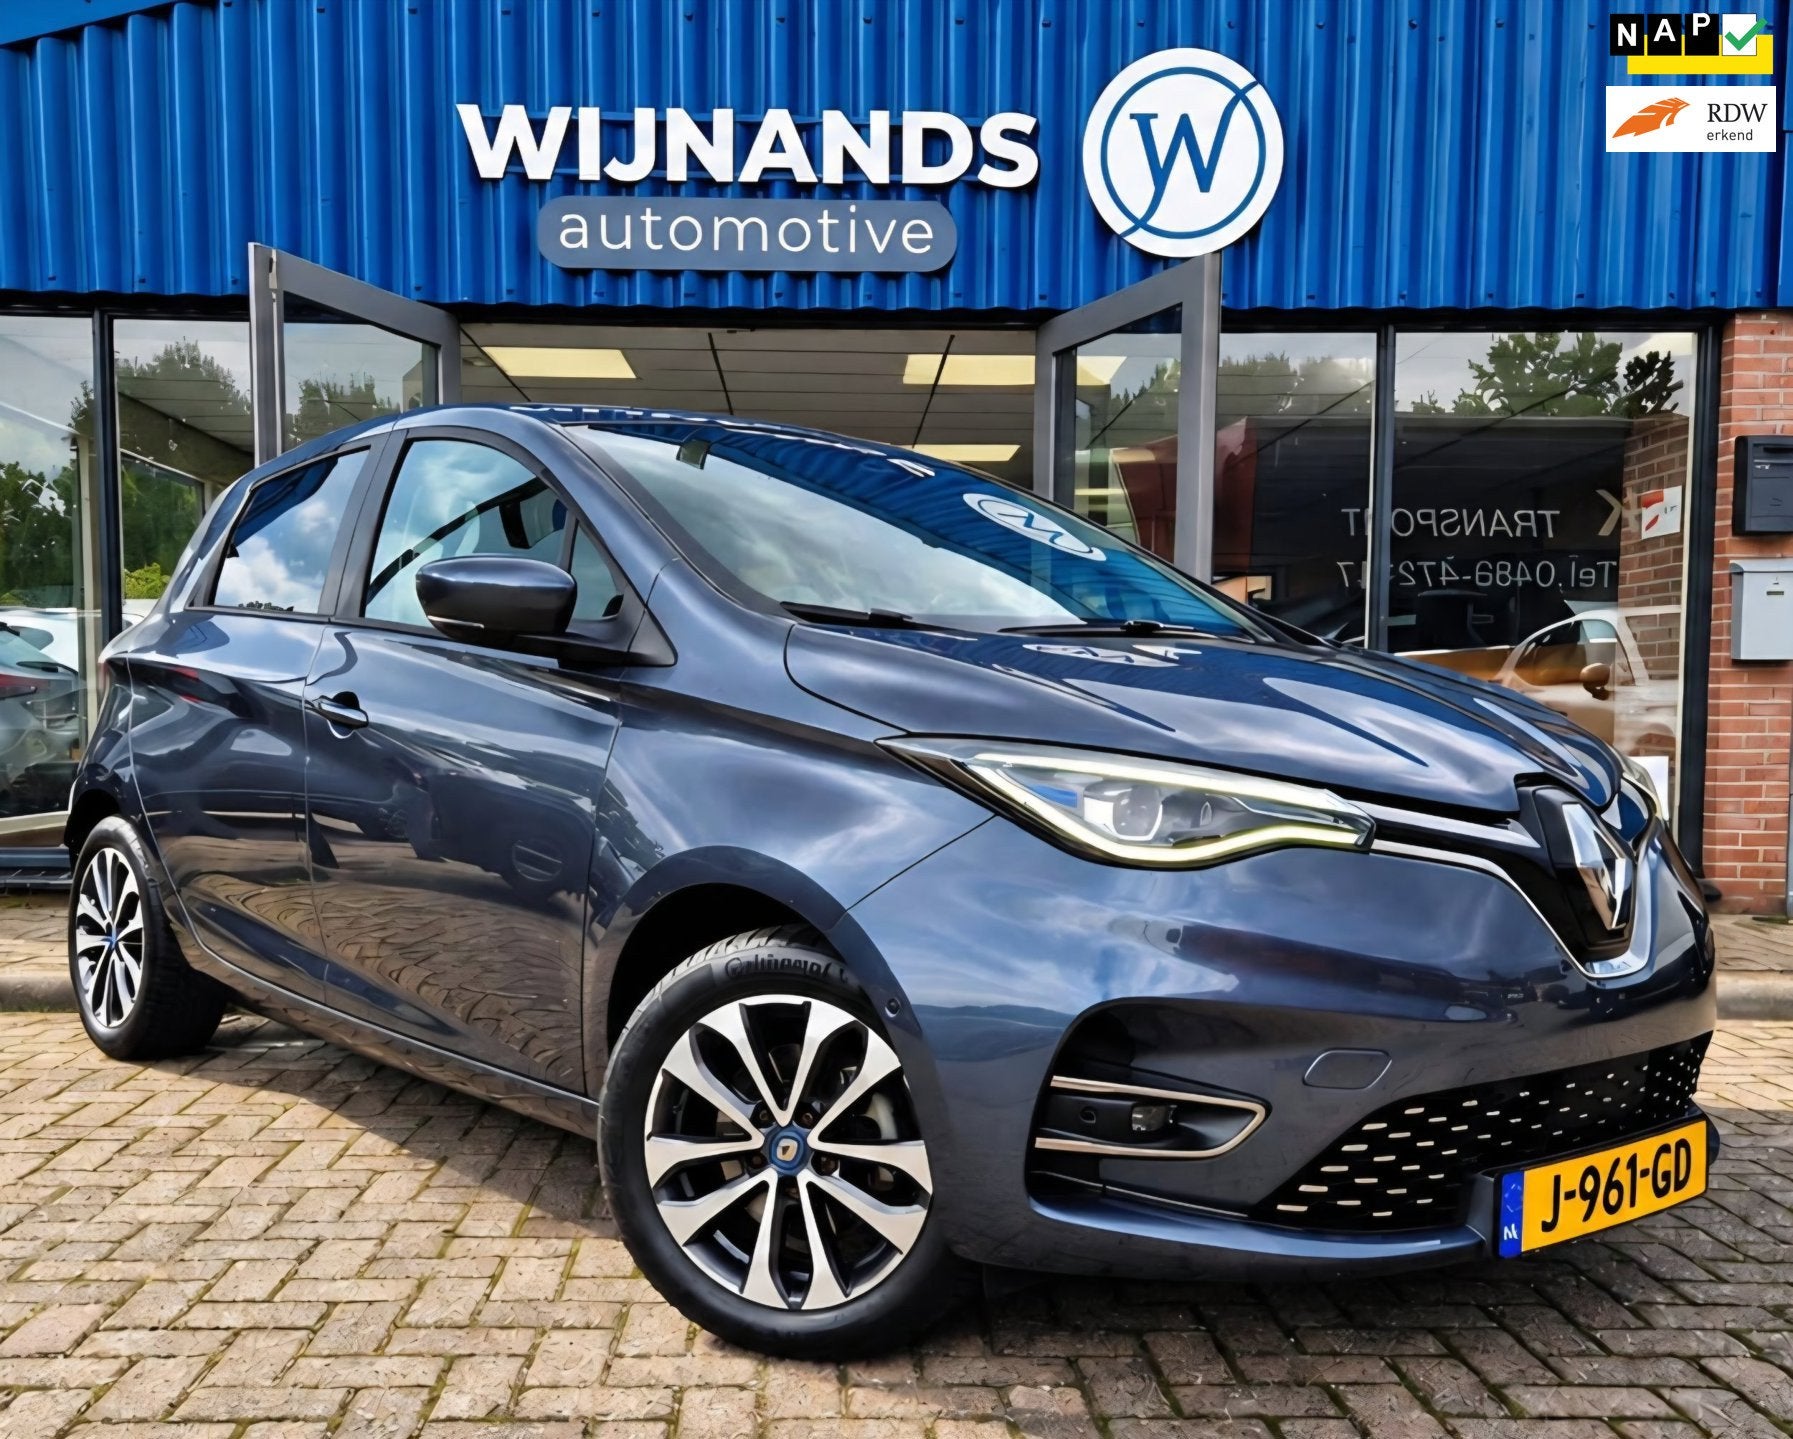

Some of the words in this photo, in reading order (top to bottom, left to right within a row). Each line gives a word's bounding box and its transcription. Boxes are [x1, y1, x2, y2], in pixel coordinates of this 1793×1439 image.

[457, 103, 1039, 188] WIJNANDS
[559, 205, 934, 255] automotive
[1541, 1138, 1692, 1233] J-961-GD
